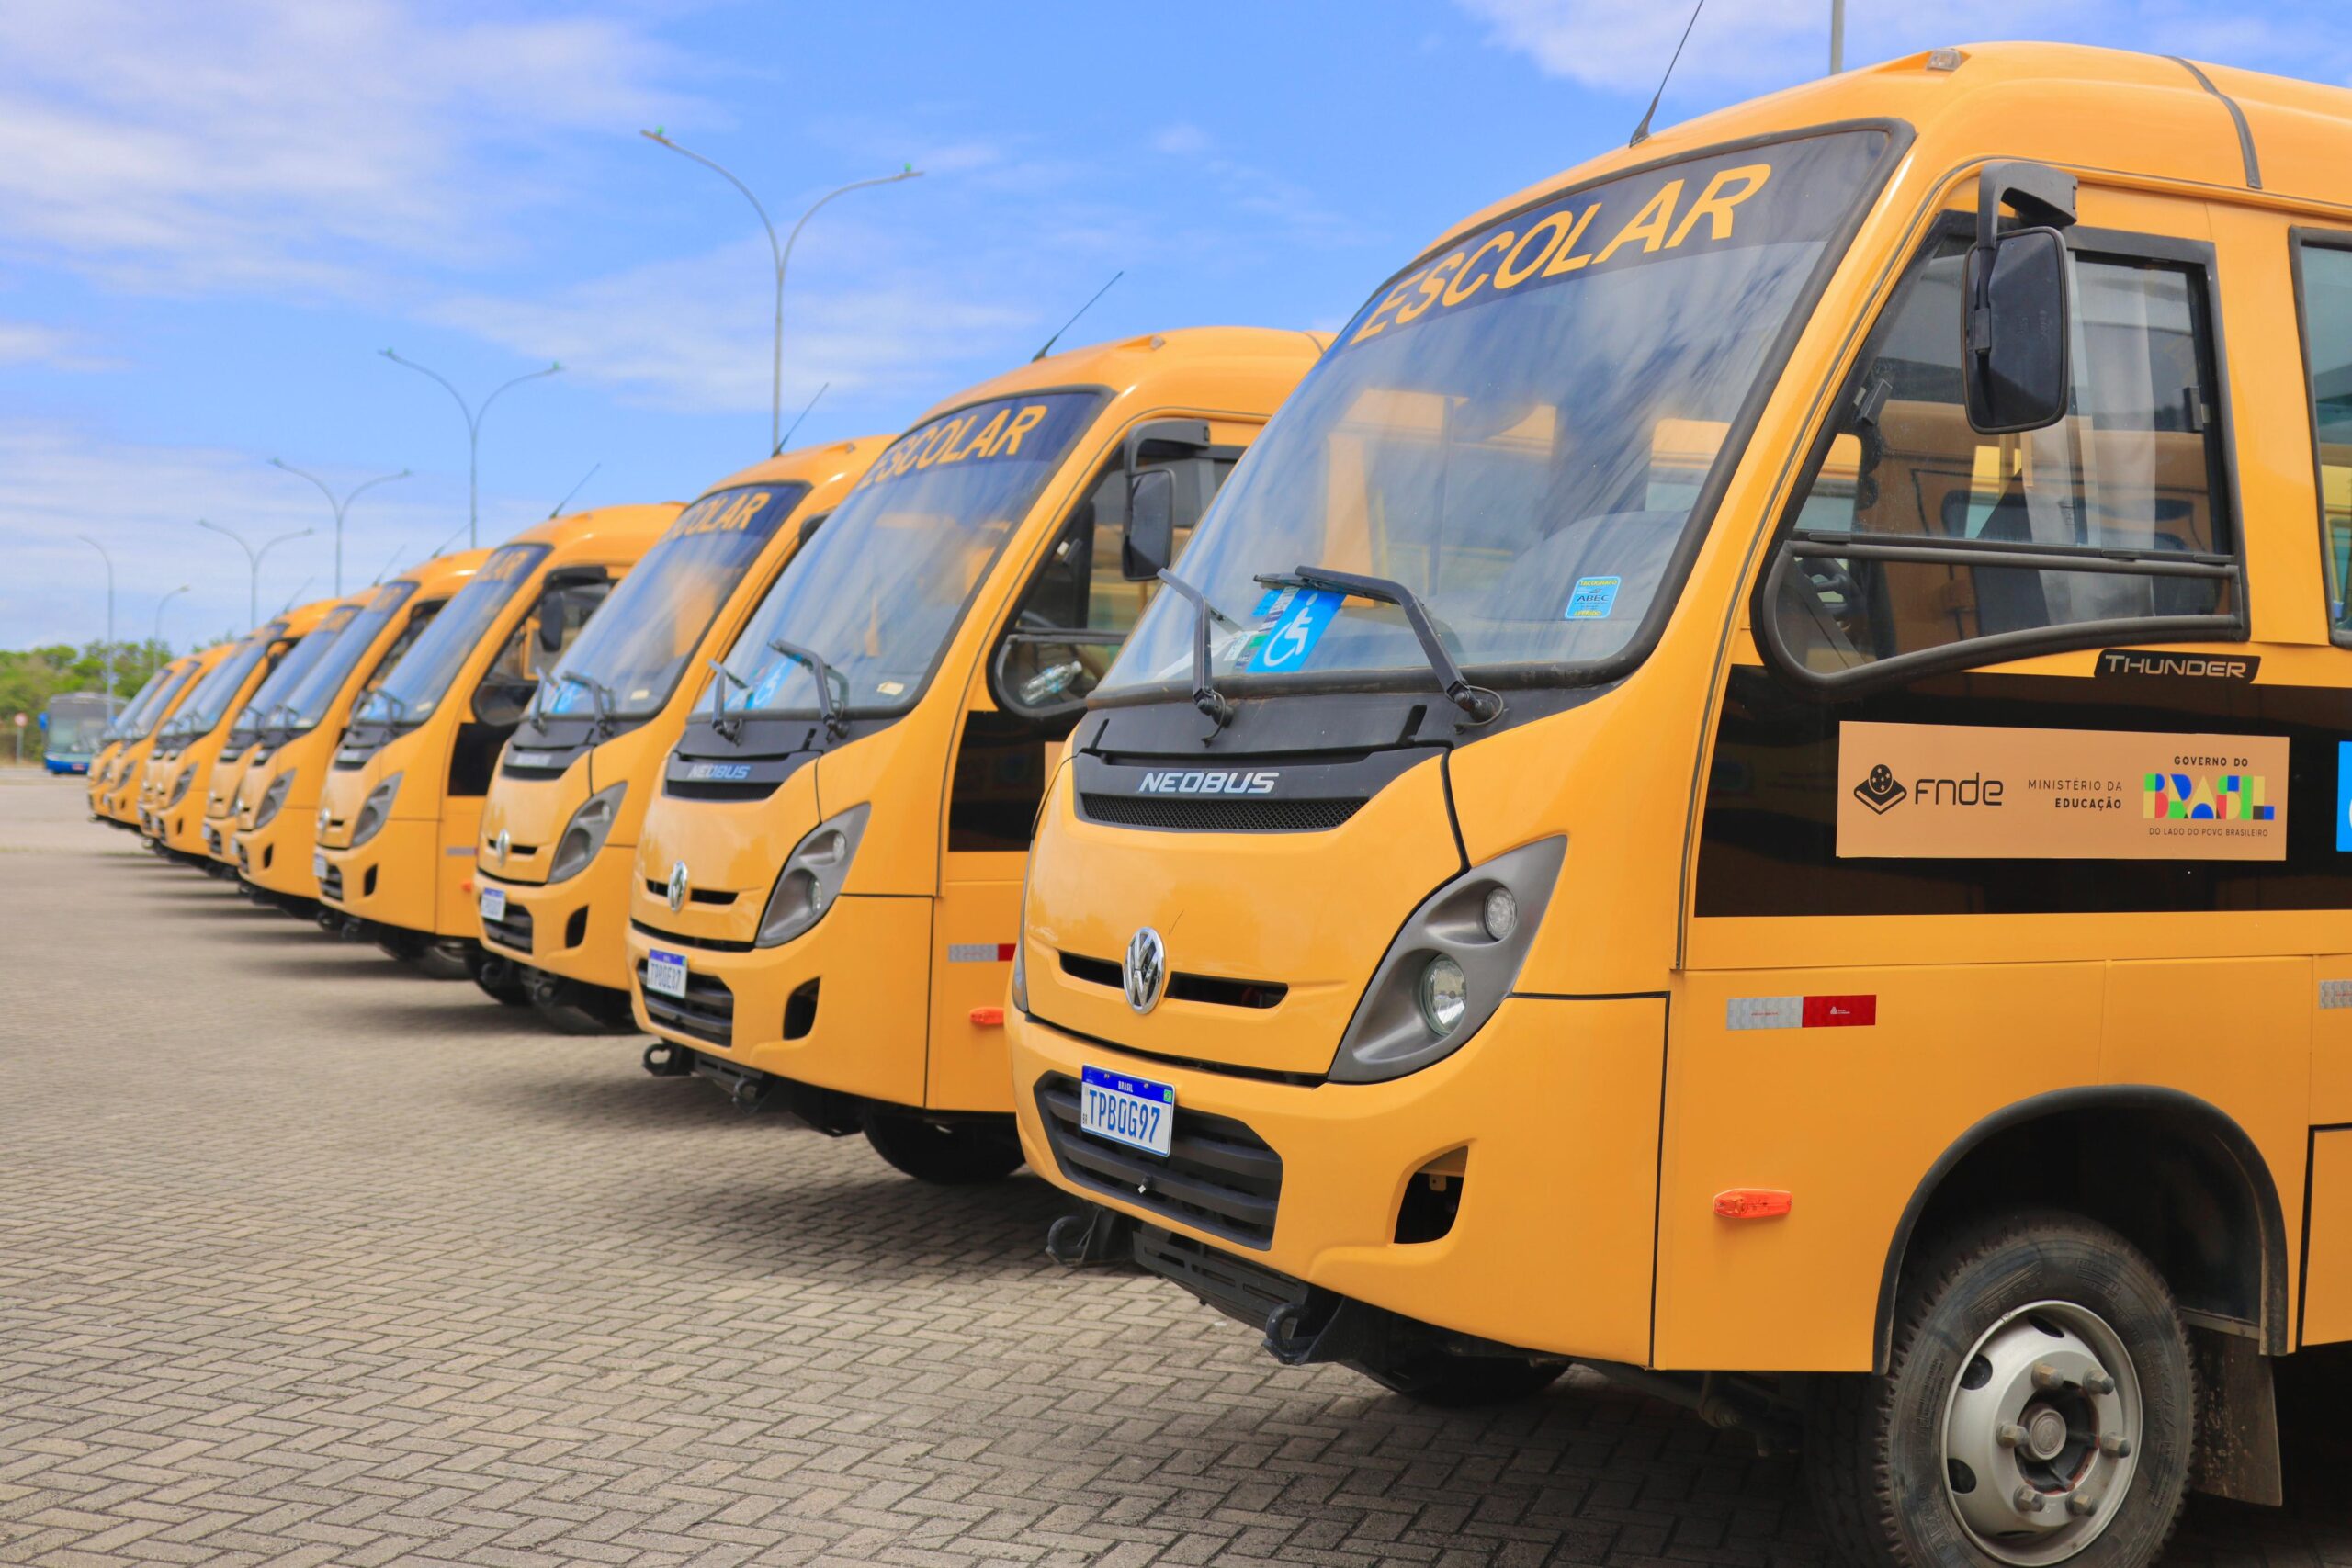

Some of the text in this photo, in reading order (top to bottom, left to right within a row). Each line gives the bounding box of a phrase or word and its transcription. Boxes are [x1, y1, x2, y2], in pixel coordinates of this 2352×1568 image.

[1351, 163, 1771, 344] ESCOLAR
[2105, 654, 2247, 678] THUNDER
[2174, 756, 2248, 767] GOVERNO DO
[686, 764, 751, 779] NEOBUS
[1138, 772, 1280, 793] NEOBUS
[2028, 777, 2122, 791] MINISTÉRIO DA
[2054, 795, 2122, 812] EDUCAÇÃO
[2143, 773, 2274, 820] BRASIL
[2149, 828, 2268, 837] DO LADO DO POVO BRASILEIRO
[1117, 1080, 1134, 1093] BRASIL
